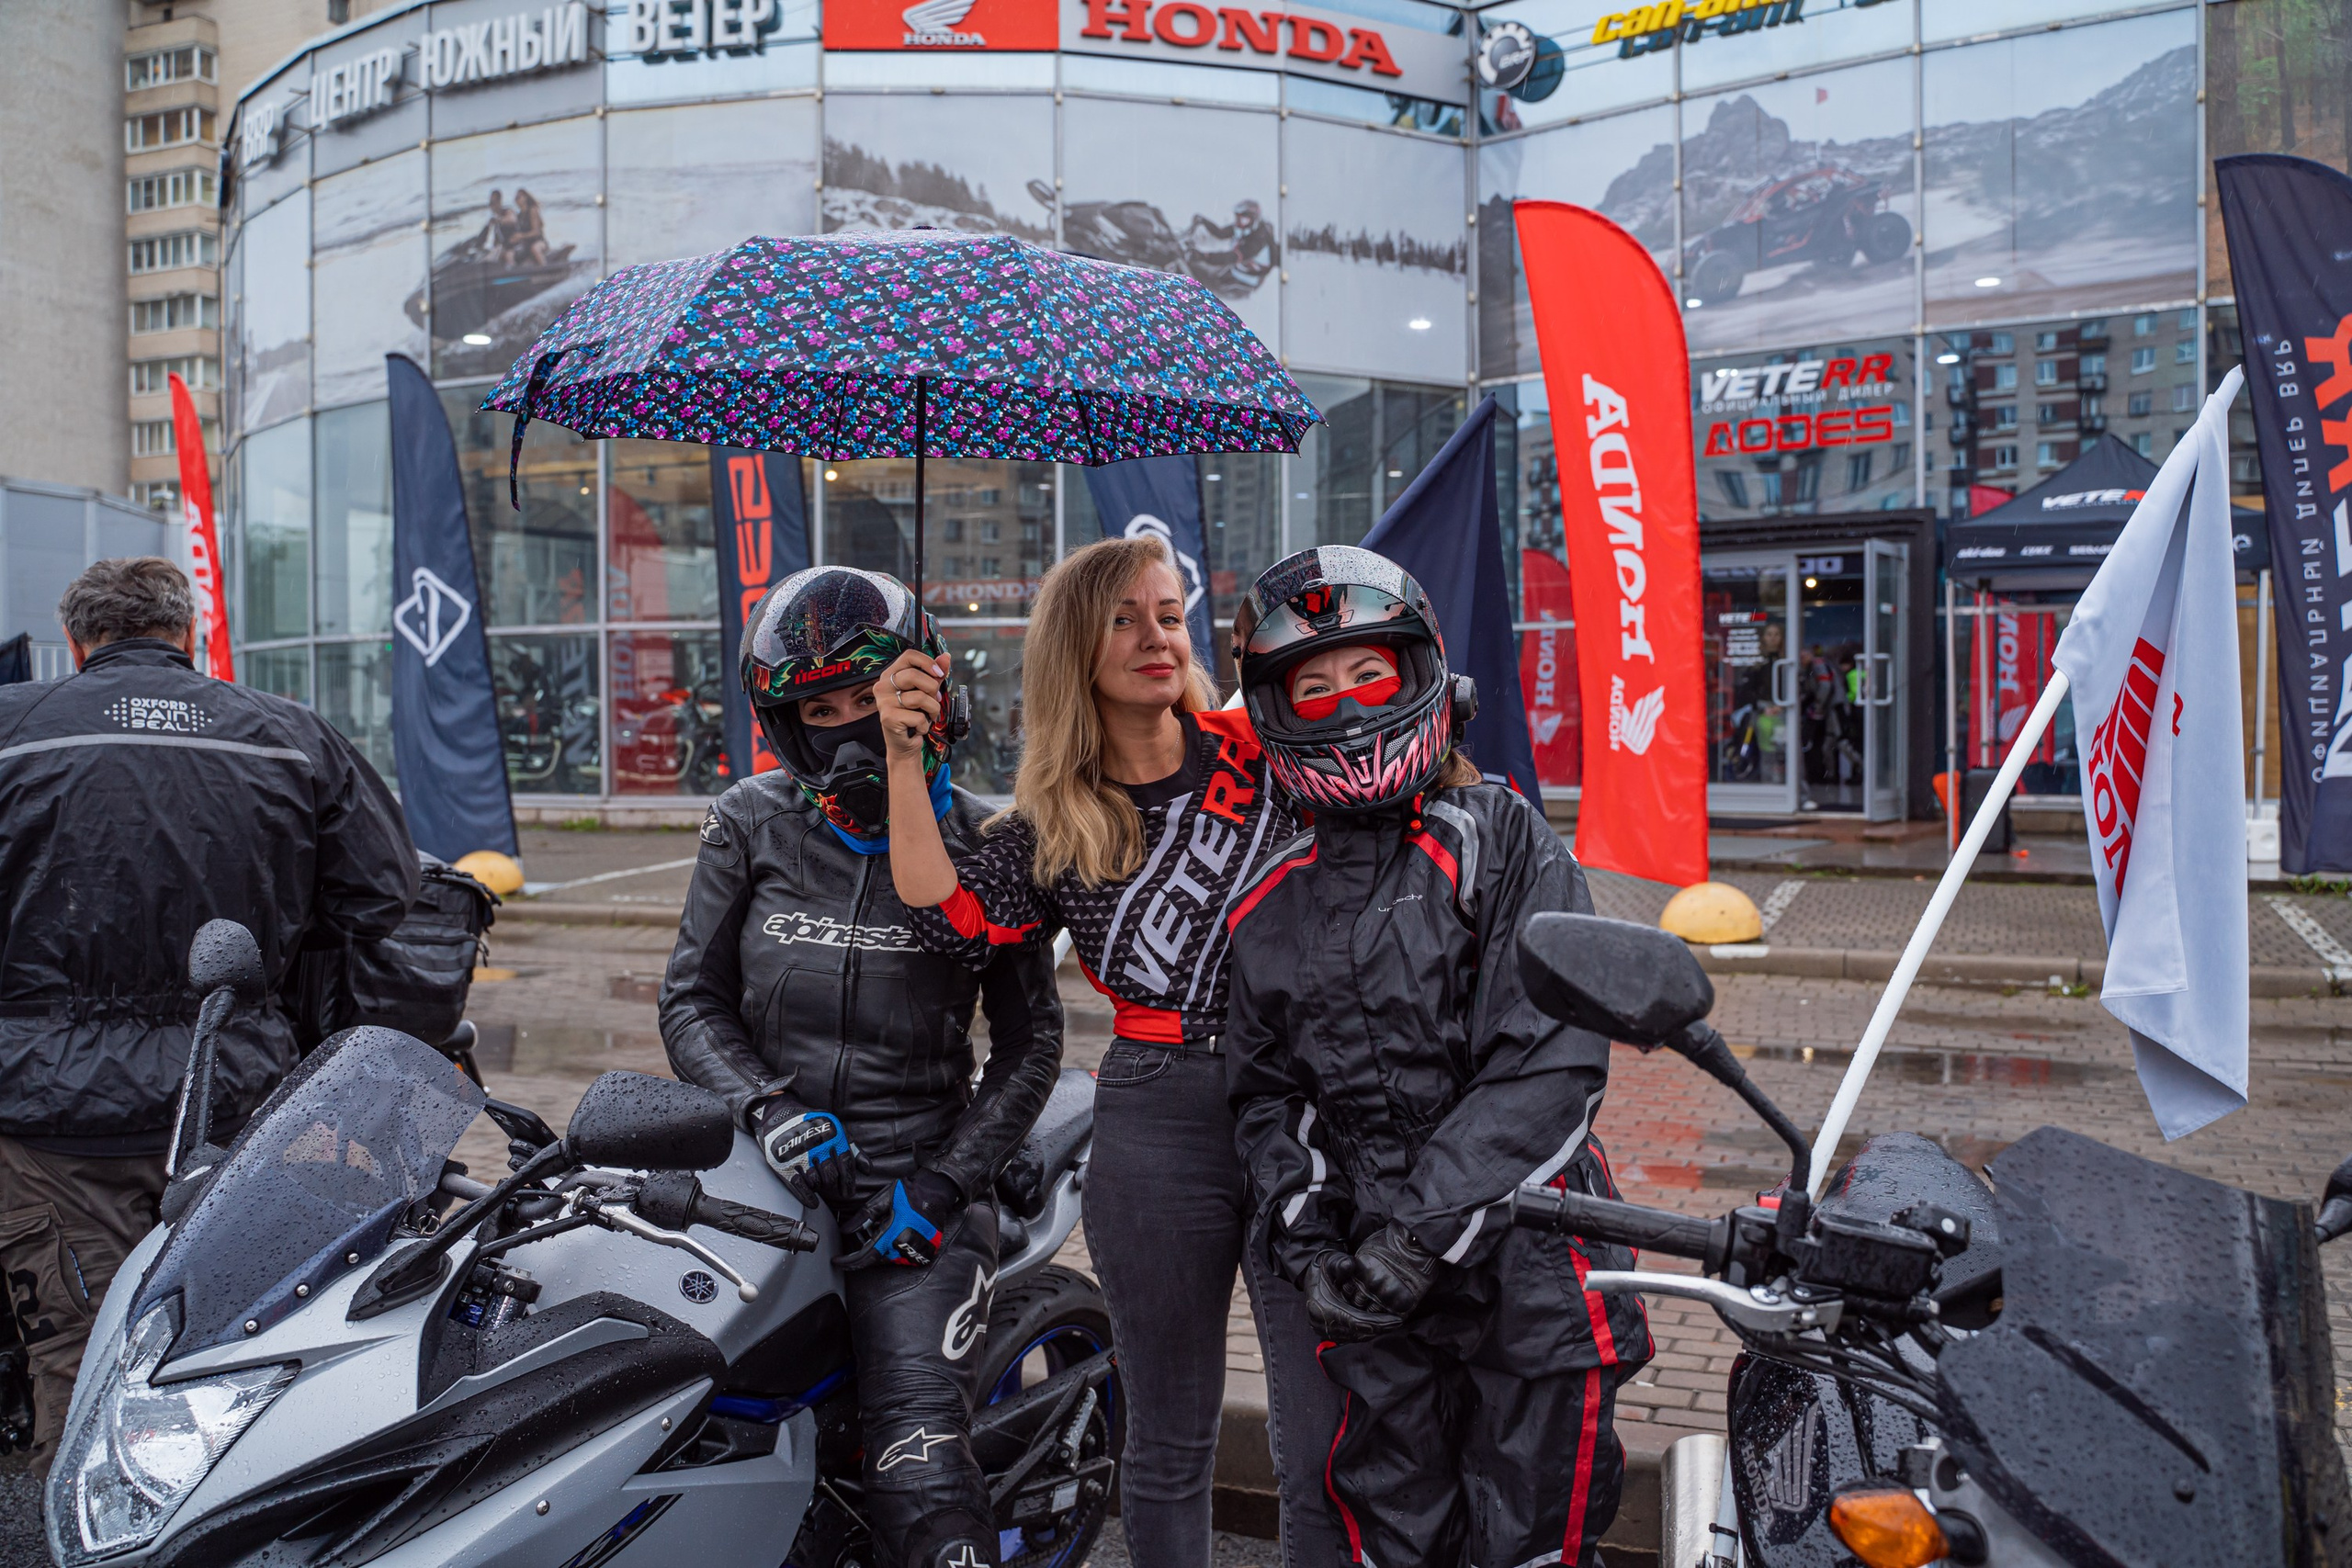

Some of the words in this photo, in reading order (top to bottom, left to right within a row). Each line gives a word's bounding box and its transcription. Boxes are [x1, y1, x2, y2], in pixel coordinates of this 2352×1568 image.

[901, 31, 986, 46] HONDA
[1081, 0, 1403, 77] HONDA
[311, 47, 401, 129] ЦЕНТР
[418, 2, 588, 90] ЮЖНЫЙ
[1498, 48, 1531, 70] BRP
[1701, 353, 1894, 402] VETERR
[1838, 381, 1894, 401] ДИЛЕР
[1703, 405, 1894, 457] AODES
[130, 697, 187, 711] OXFORD
[130, 707, 189, 723] RAIN
[131, 719, 190, 732] SEAL
[777, 1122, 831, 1157] DAINESE
[1739, 1438, 1775, 1535] HONDA
